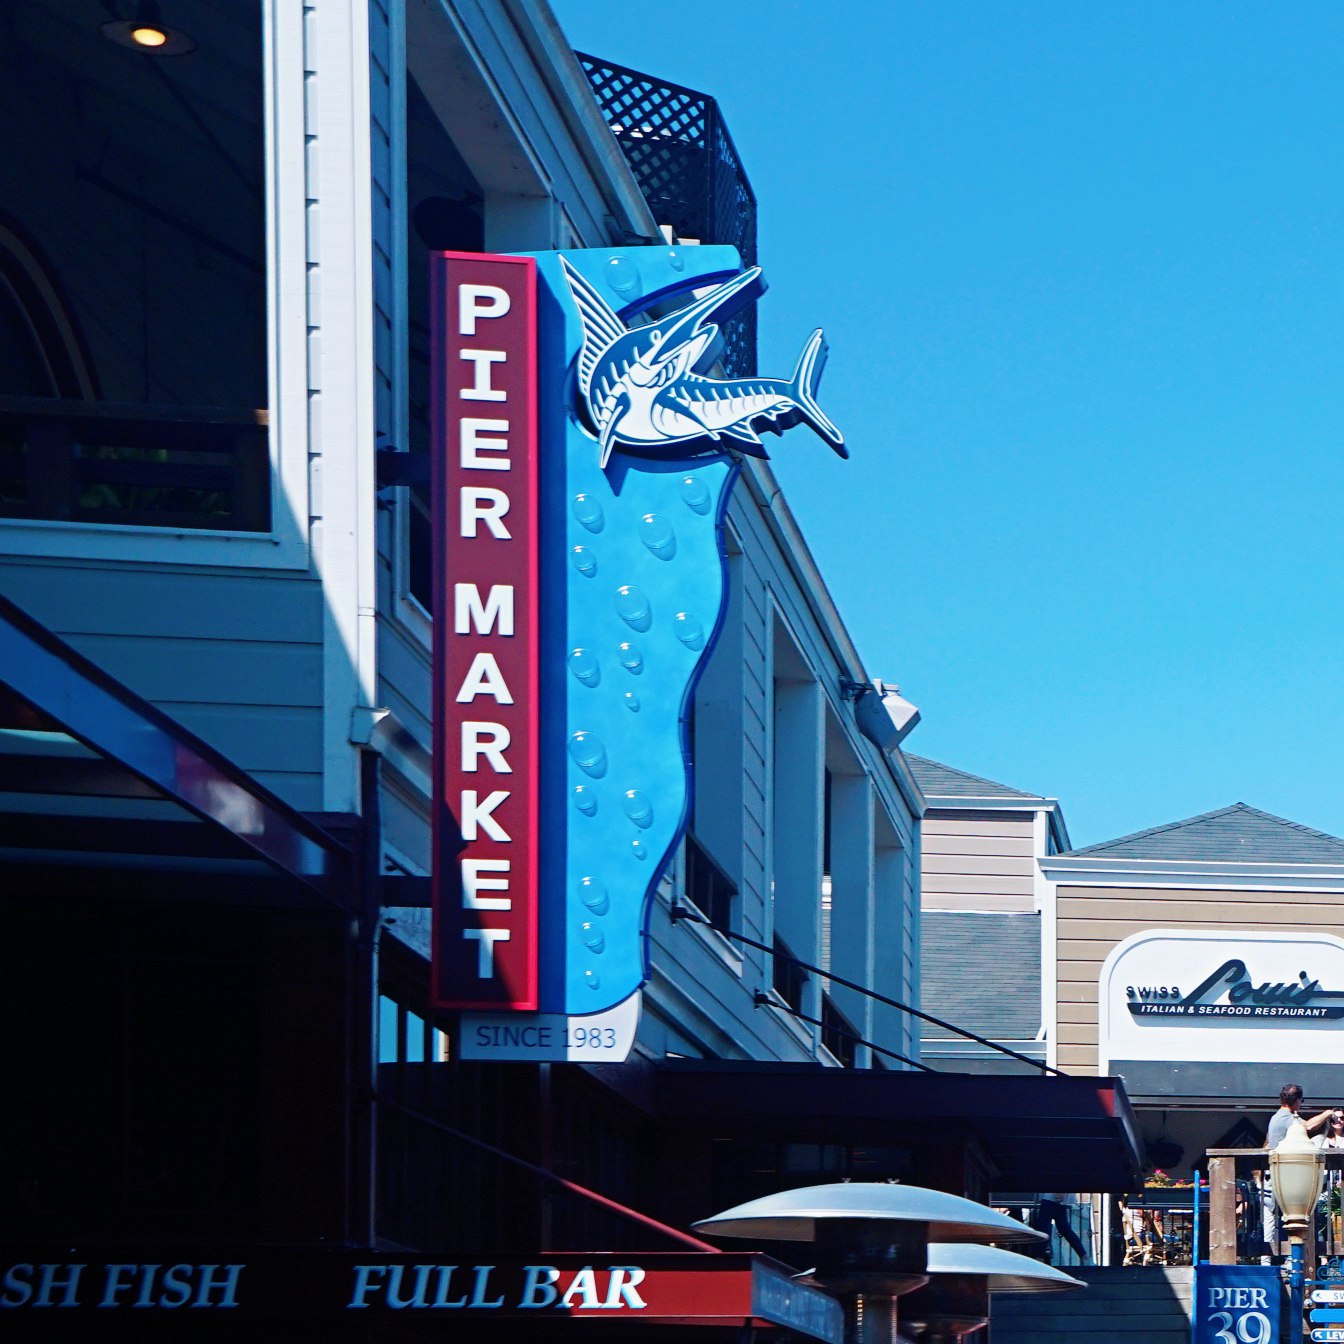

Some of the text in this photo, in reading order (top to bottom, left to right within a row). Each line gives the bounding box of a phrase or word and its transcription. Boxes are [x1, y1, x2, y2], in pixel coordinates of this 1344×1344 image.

[453, 283, 515, 980] PIER MARKET
[1126, 986, 1180, 1000] SWISS
[1140, 1005, 1328, 1017] ITALIAN & SEAFOOD RESTAURANT
[475, 1026, 616, 1049] SINCE 1983
[101, 1264, 247, 1309] FISH
[346, 1264, 648, 1310] FULL BAR
[1207, 1287, 1270, 1309] PIER
